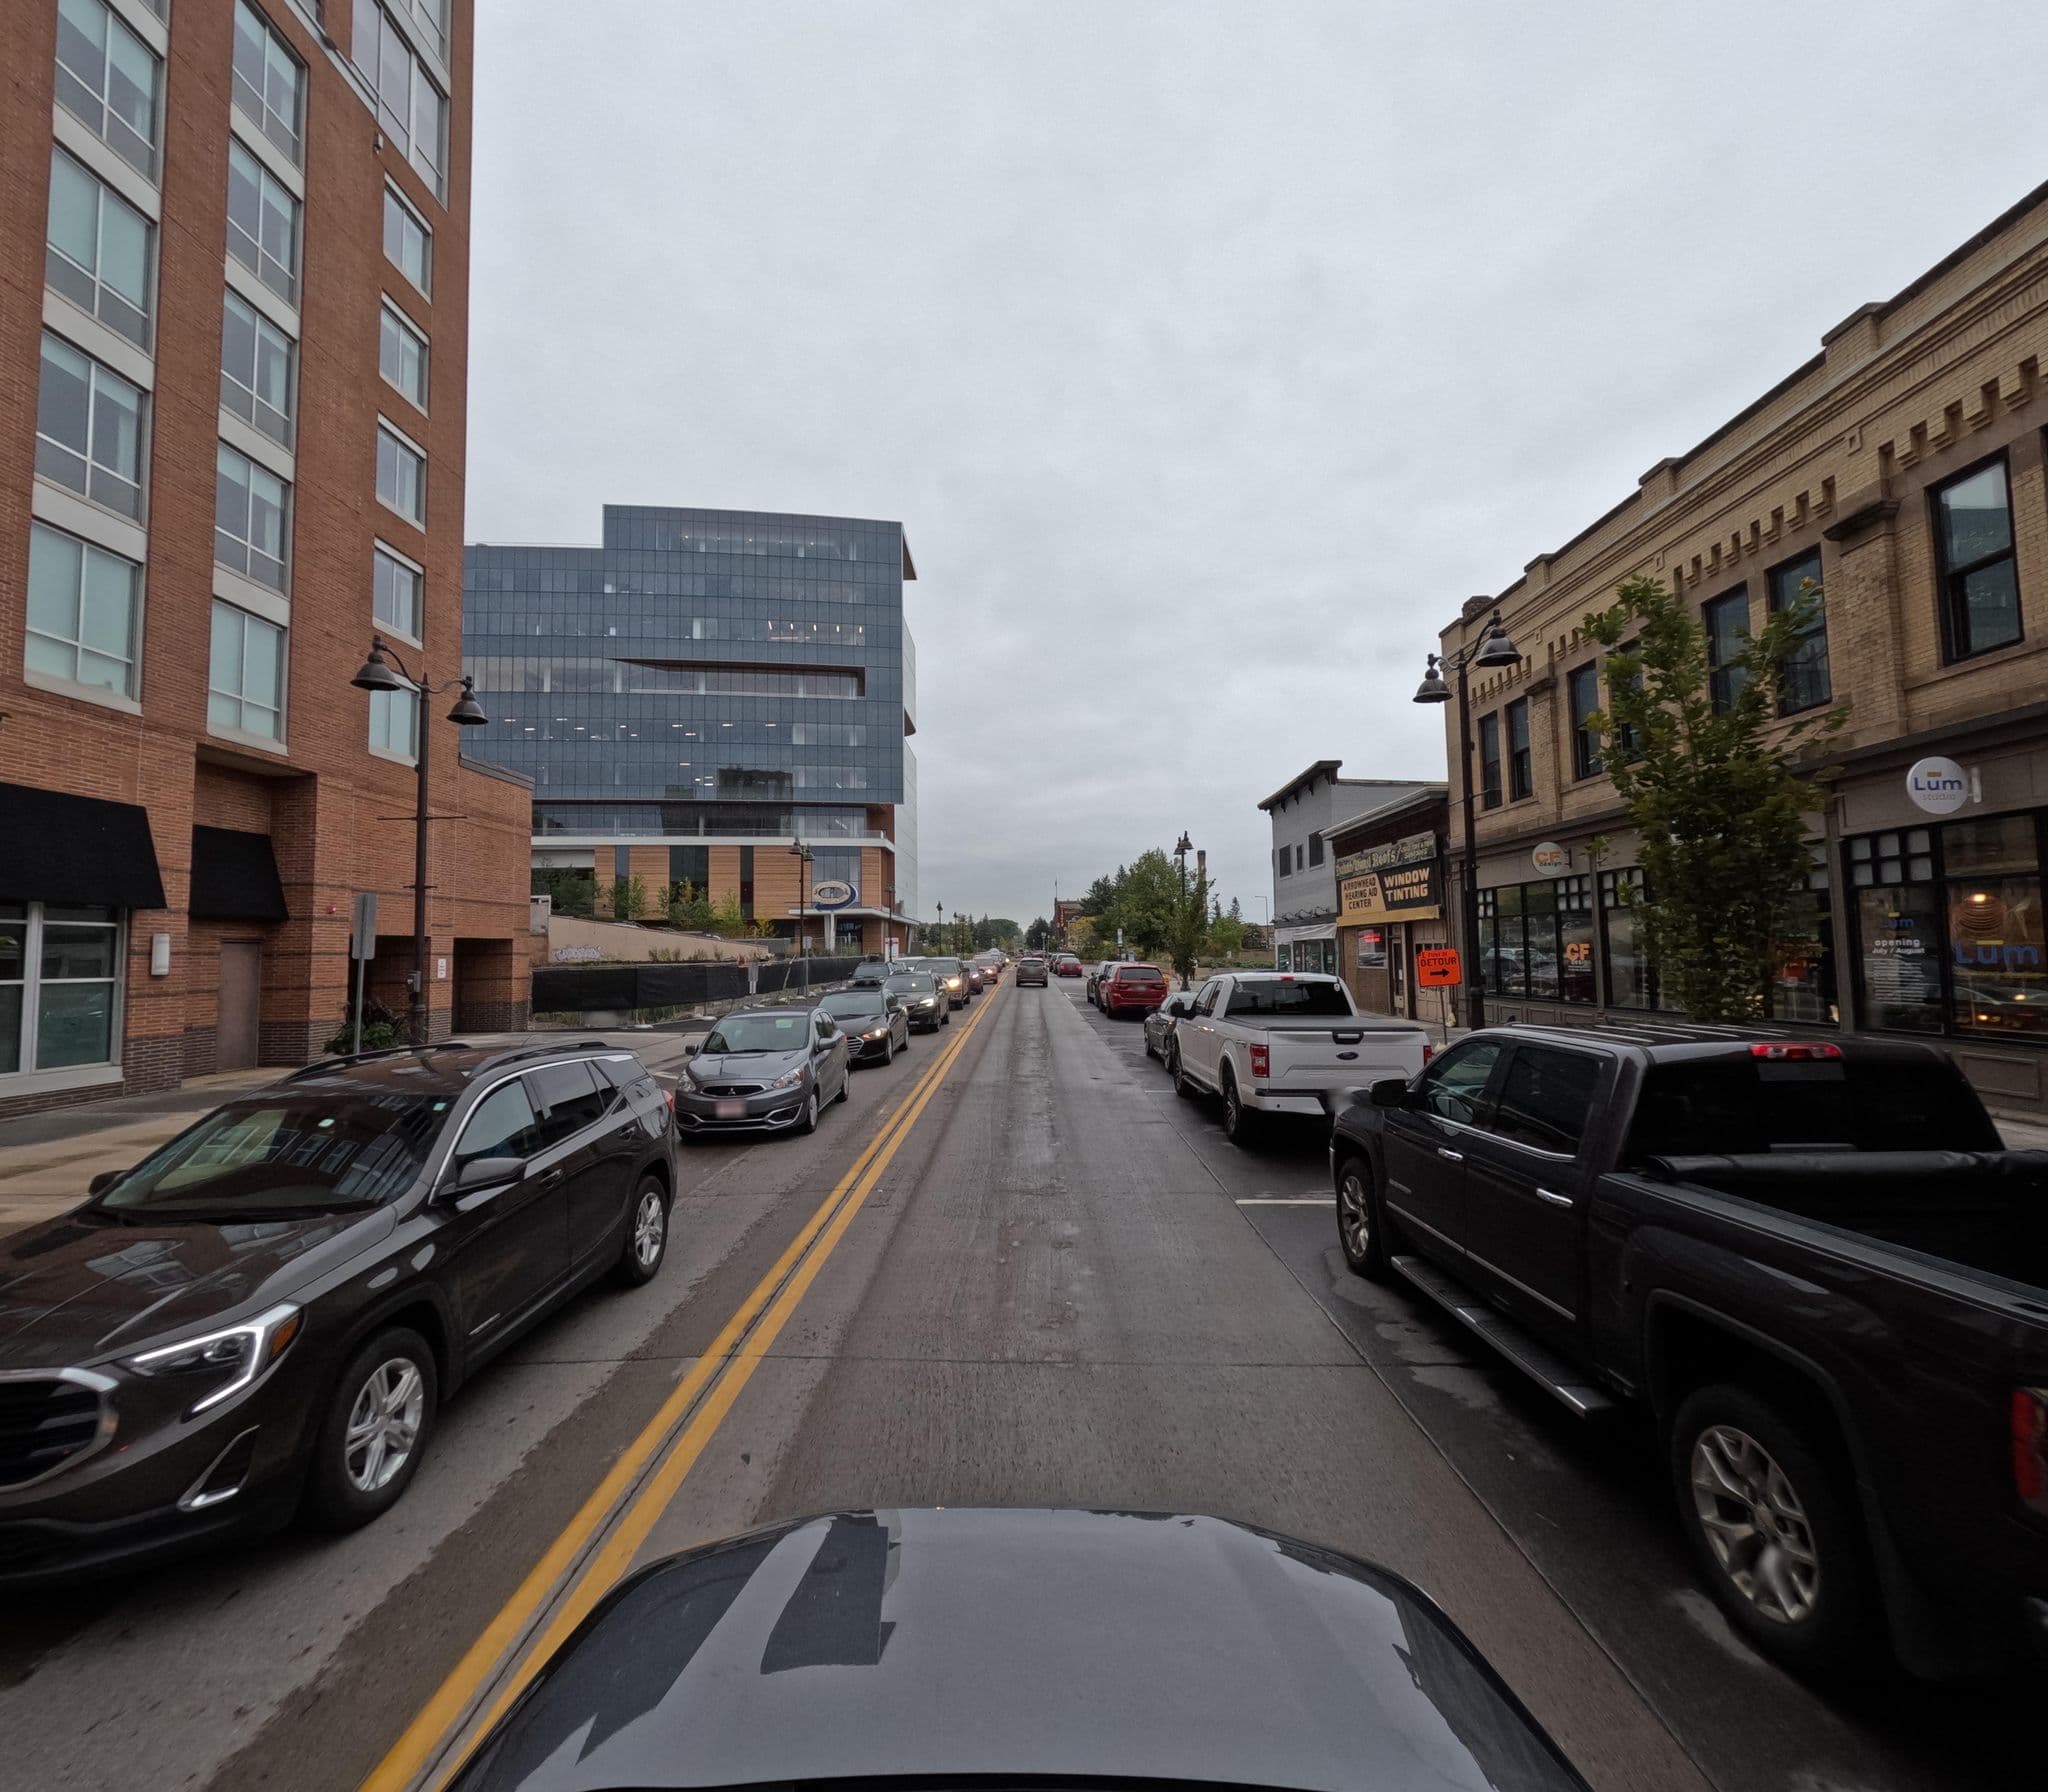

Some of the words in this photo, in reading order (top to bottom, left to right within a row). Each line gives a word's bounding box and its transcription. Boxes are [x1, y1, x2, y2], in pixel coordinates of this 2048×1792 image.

[1914, 777, 1962, 791] Lum
[1535, 851, 1561, 864] CF
[1343, 877, 1376, 890] ARROWHEAD
[1384, 867, 1430, 888] WINDOW
[1344, 889, 1367, 900] HEARING
[1368, 887, 1378, 897] AID
[1385, 884, 1428, 902] TINTING
[1348, 898, 1372, 910] CENTER
[1874, 938, 1921, 948] opening
[1566, 943, 1591, 960] CF
[1895, 947, 1926, 955] August
[1955, 943, 2039, 965] Lum
[1420, 957, 1457, 967] DETOUR
